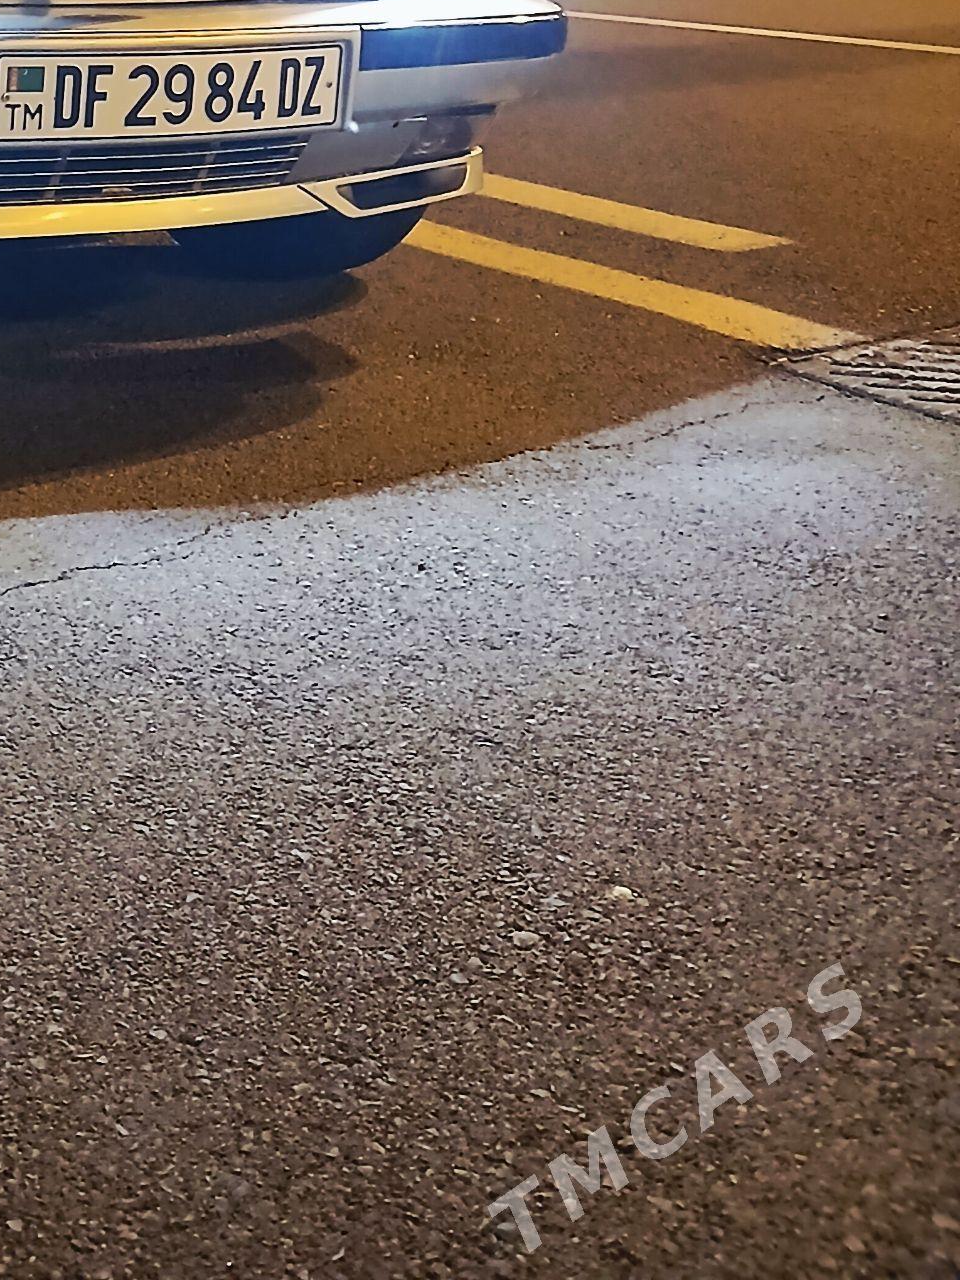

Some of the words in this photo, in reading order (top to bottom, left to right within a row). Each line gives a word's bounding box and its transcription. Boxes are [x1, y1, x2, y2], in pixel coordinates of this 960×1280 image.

[5, 103, 43, 131] TM
[53, 65, 113, 128] DF
[277, 56, 325, 118] DZ
